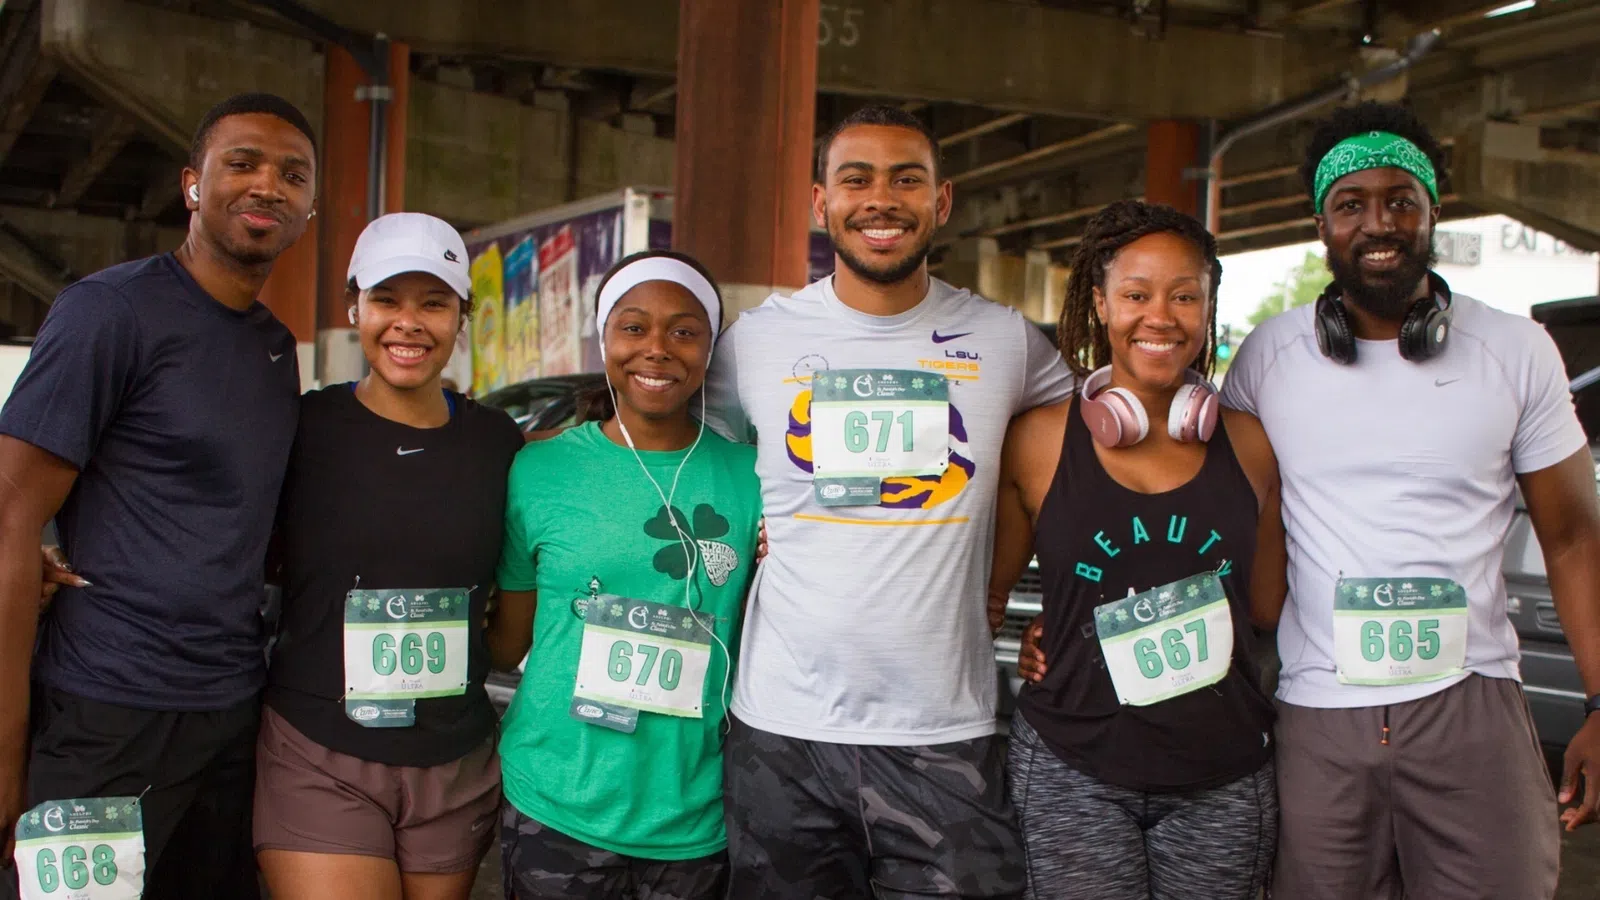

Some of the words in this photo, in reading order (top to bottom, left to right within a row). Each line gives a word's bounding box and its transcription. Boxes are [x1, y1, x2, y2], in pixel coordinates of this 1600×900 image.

[916, 359, 979, 372] TIGERS
[944, 349, 978, 360] LSU
[844, 410, 914, 453] 671
[372, 631, 446, 676] 669
[1133, 618, 1208, 680] 667
[1360, 619, 1440, 662] 665
[607, 640, 683, 691] 670
[36, 844, 118, 893] 668
